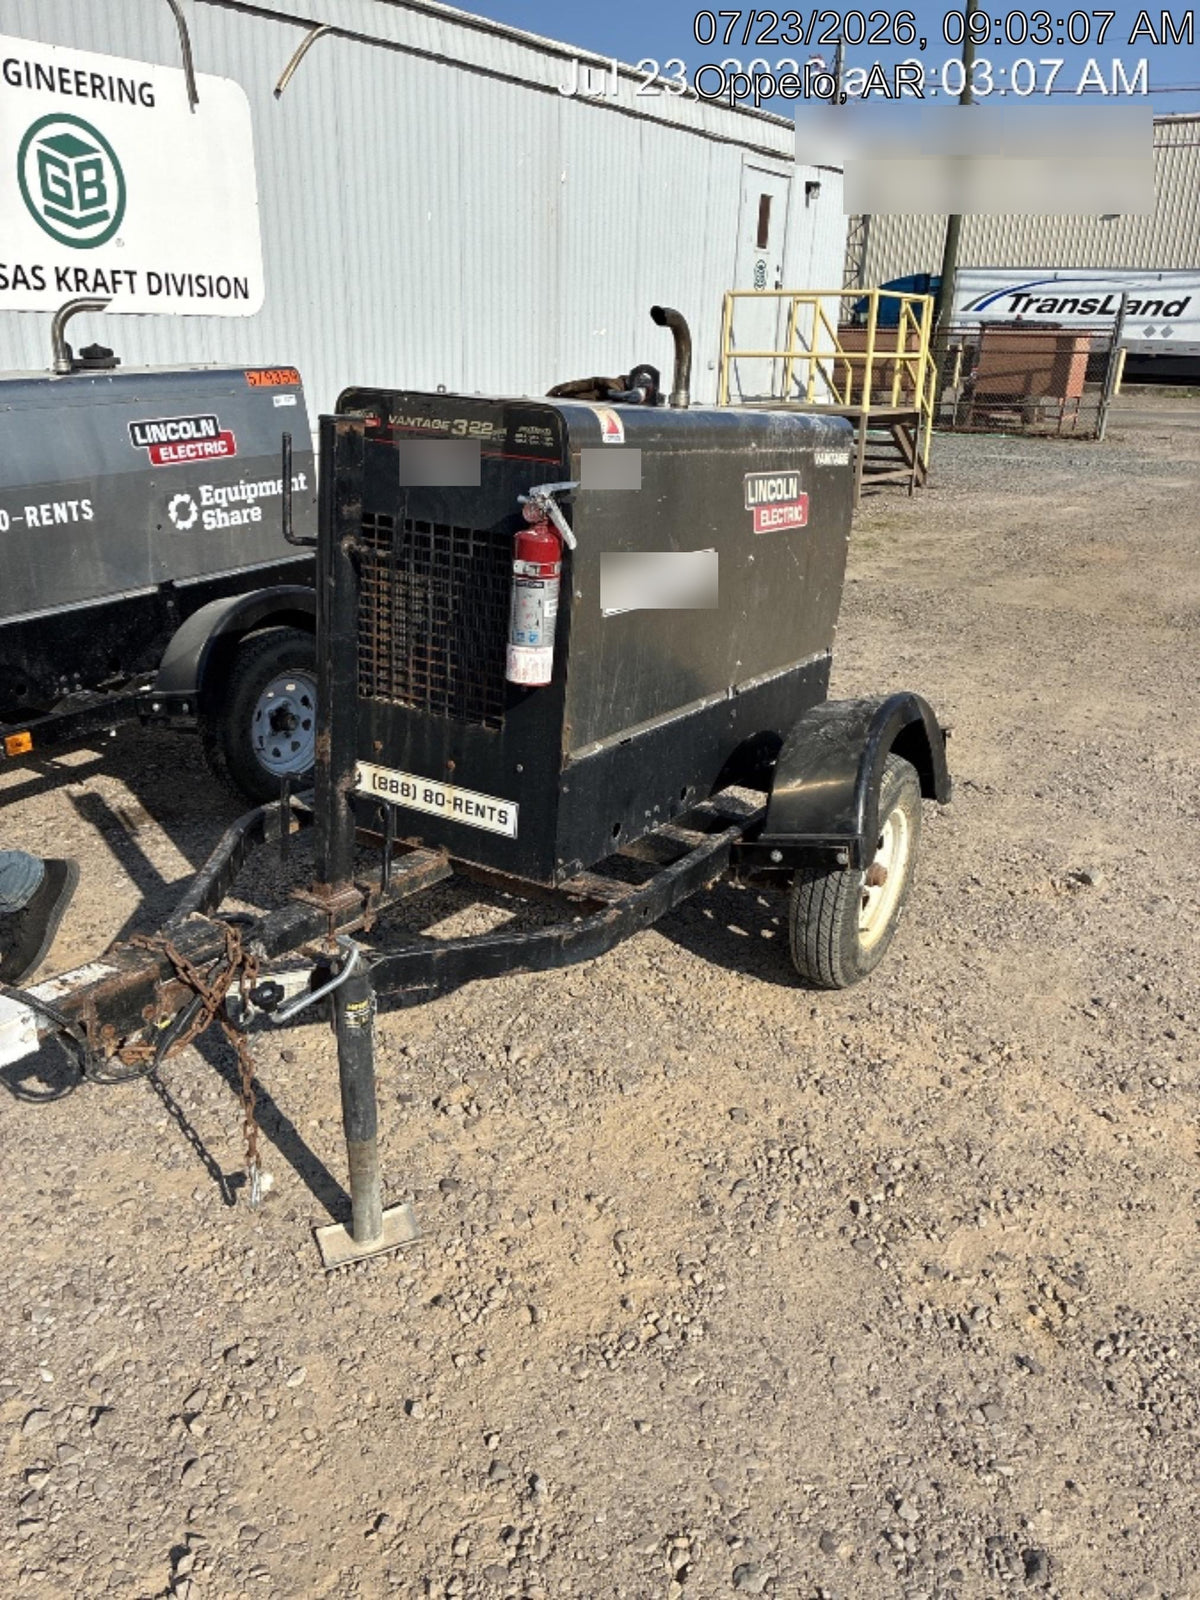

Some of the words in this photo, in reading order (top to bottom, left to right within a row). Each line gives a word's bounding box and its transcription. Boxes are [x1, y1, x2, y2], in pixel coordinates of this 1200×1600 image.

[54, 266, 138, 295] KRAFT
[146, 271, 250, 300] DIVISION
[1007, 293, 1193, 318] TransLand
[134, 418, 217, 445] LINCOLN
[388, 414, 452, 431] VANTAGE
[452, 418, 494, 438] 322
[158, 440, 229, 462] ELECTRIC
[198, 472, 309, 508] Equipment
[747, 476, 798, 504] LINCOLN
[201, 504, 263, 531] Share
[760, 504, 803, 527] ELECTRIC
[372, 772, 417, 801] (888)
[423, 788, 509, 826] 80-RENTS
